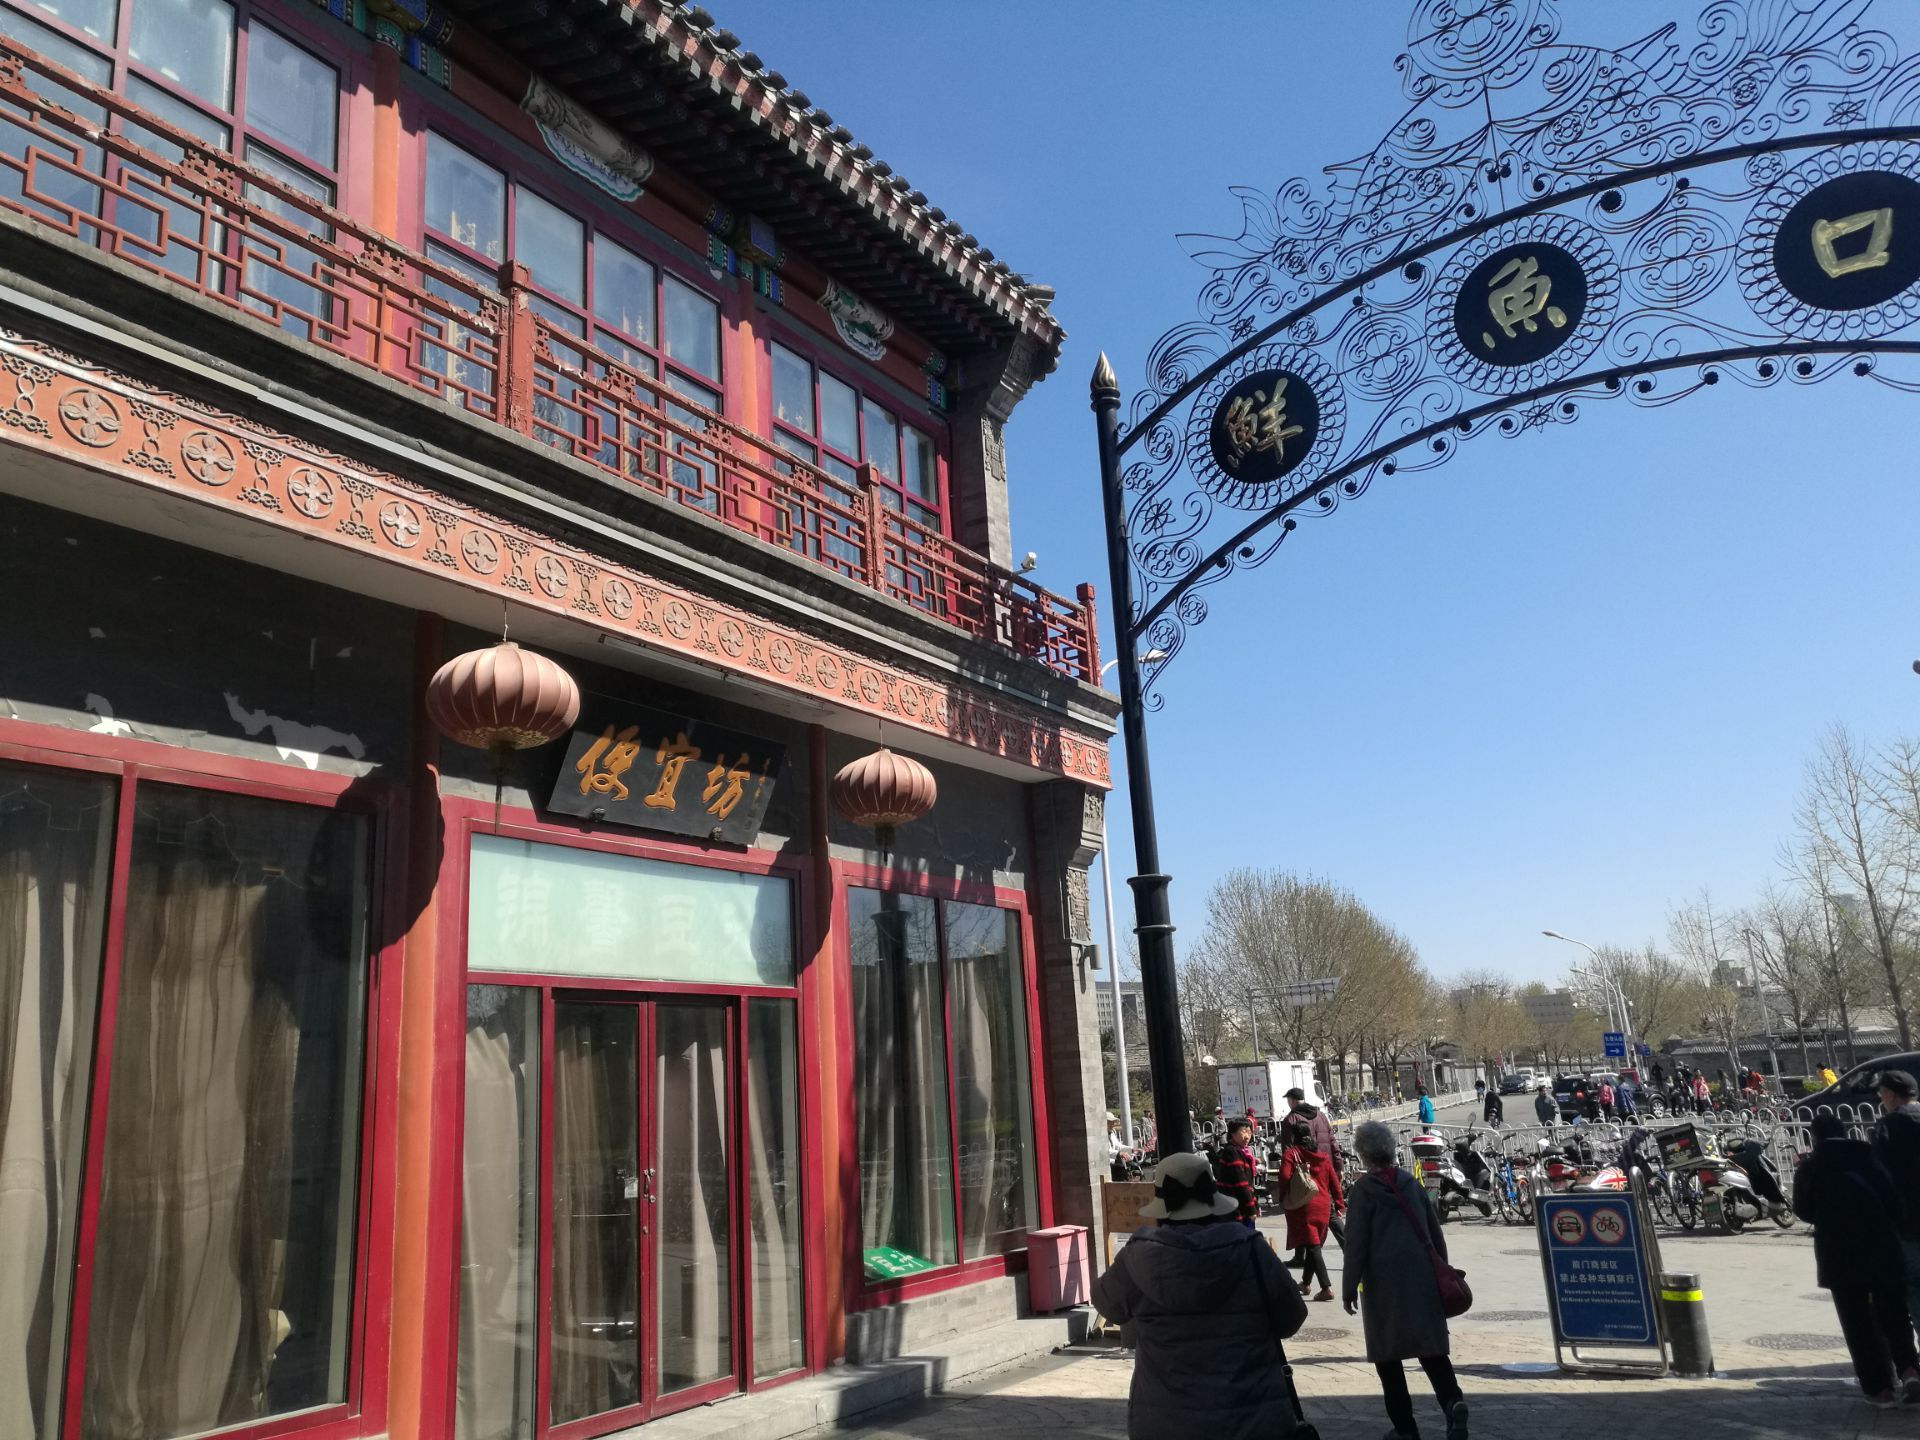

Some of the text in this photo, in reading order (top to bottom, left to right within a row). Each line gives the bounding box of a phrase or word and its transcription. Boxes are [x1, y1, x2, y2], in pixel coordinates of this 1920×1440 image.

[575, 723, 752, 823] 便宜坊
[1572, 1260, 1617, 1269] 前门商业区
[1560, 1274, 1634, 1284] 禁止各种车辆穿行
